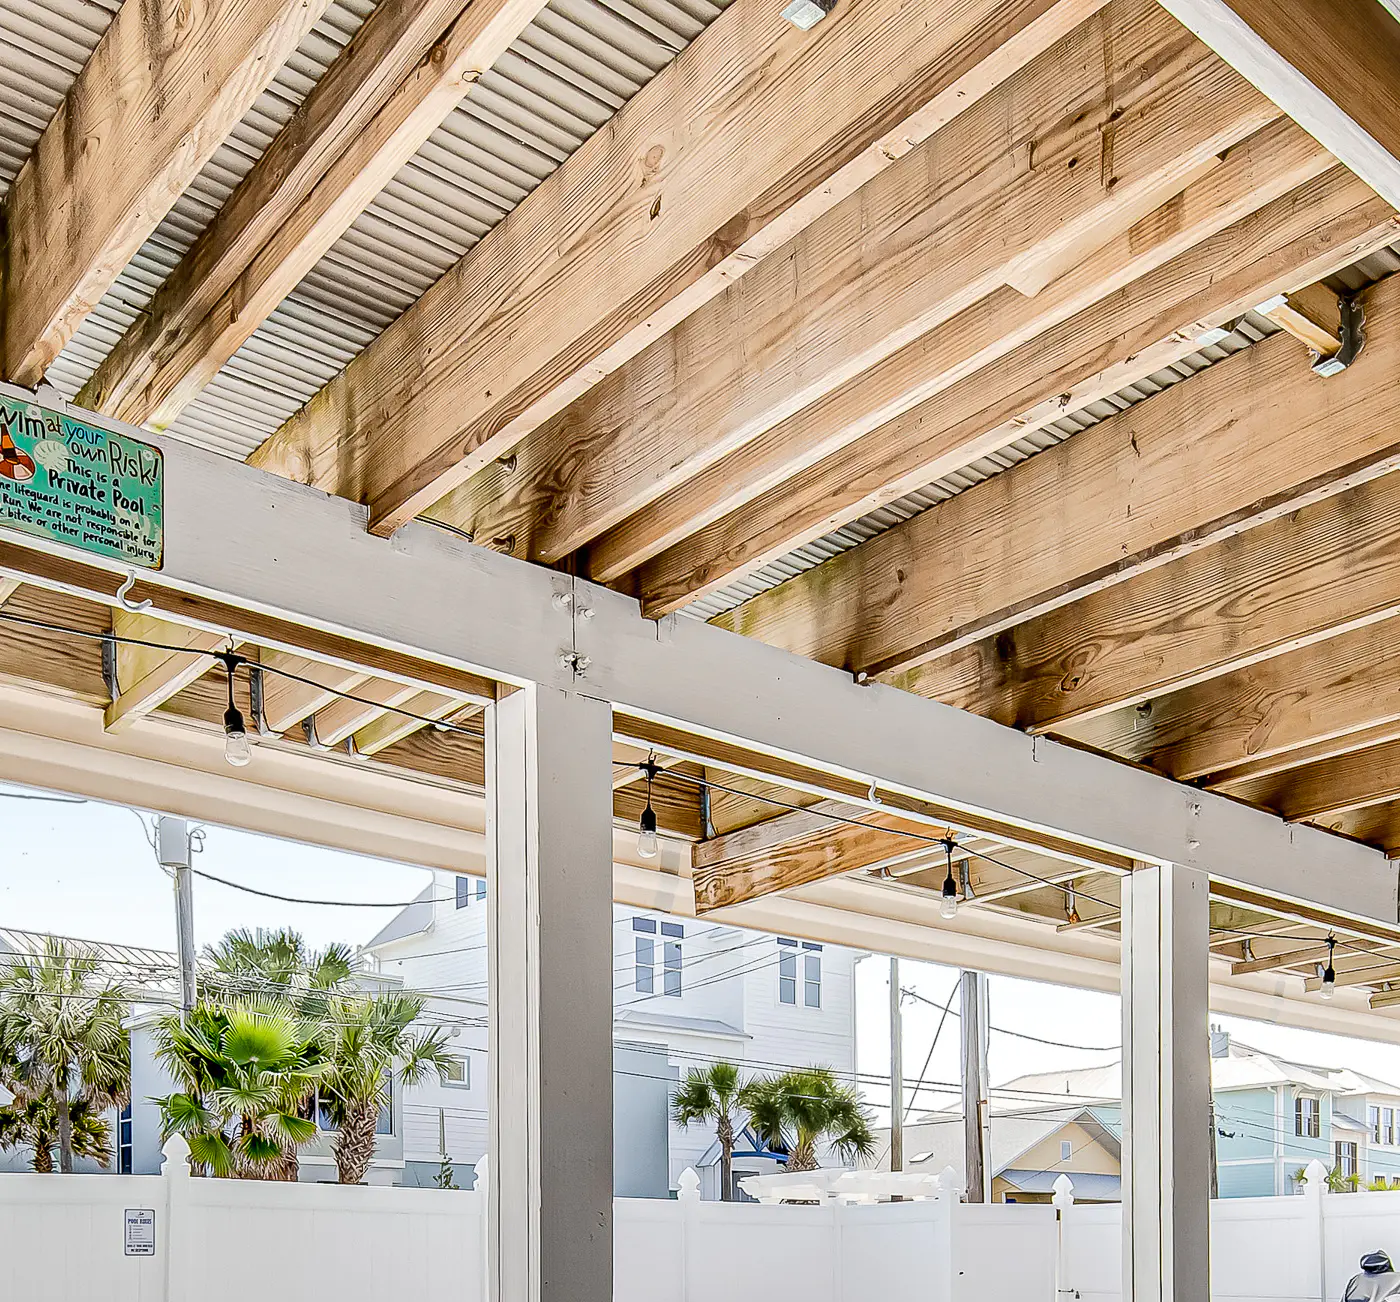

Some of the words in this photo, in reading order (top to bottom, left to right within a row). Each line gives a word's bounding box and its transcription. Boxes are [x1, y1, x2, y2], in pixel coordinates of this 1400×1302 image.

[0, 406, 46, 439] wim
[47, 416, 65, 436] at
[65, 422, 103, 445] your
[64, 457, 92, 479] This
[96, 472, 107, 483] is
[112, 478, 120, 488] a
[71, 441, 107, 462] own
[108, 440, 159, 486] Risk!
[14, 483, 59, 505] lifeguard
[62, 499, 71, 508] is
[75, 502, 116, 525] probably
[119, 517, 131, 527] on
[134, 522, 140, 530] a
[49, 469, 106, 502] Private
[113, 489, 144, 515] Pool
[2, 493, 25, 509] Run.
[27, 500, 42, 513] We
[46, 509, 62, 520] are
[65, 514, 82, 526] not
[86, 520, 138, 542] responsible
[143, 534, 156, 547] for
[8, 507, 33, 523] bites
[36, 518, 48, 527] or
[52, 522, 79, 537] other
[83, 531, 123, 550] personal
[127, 545, 157, 562] injury.
